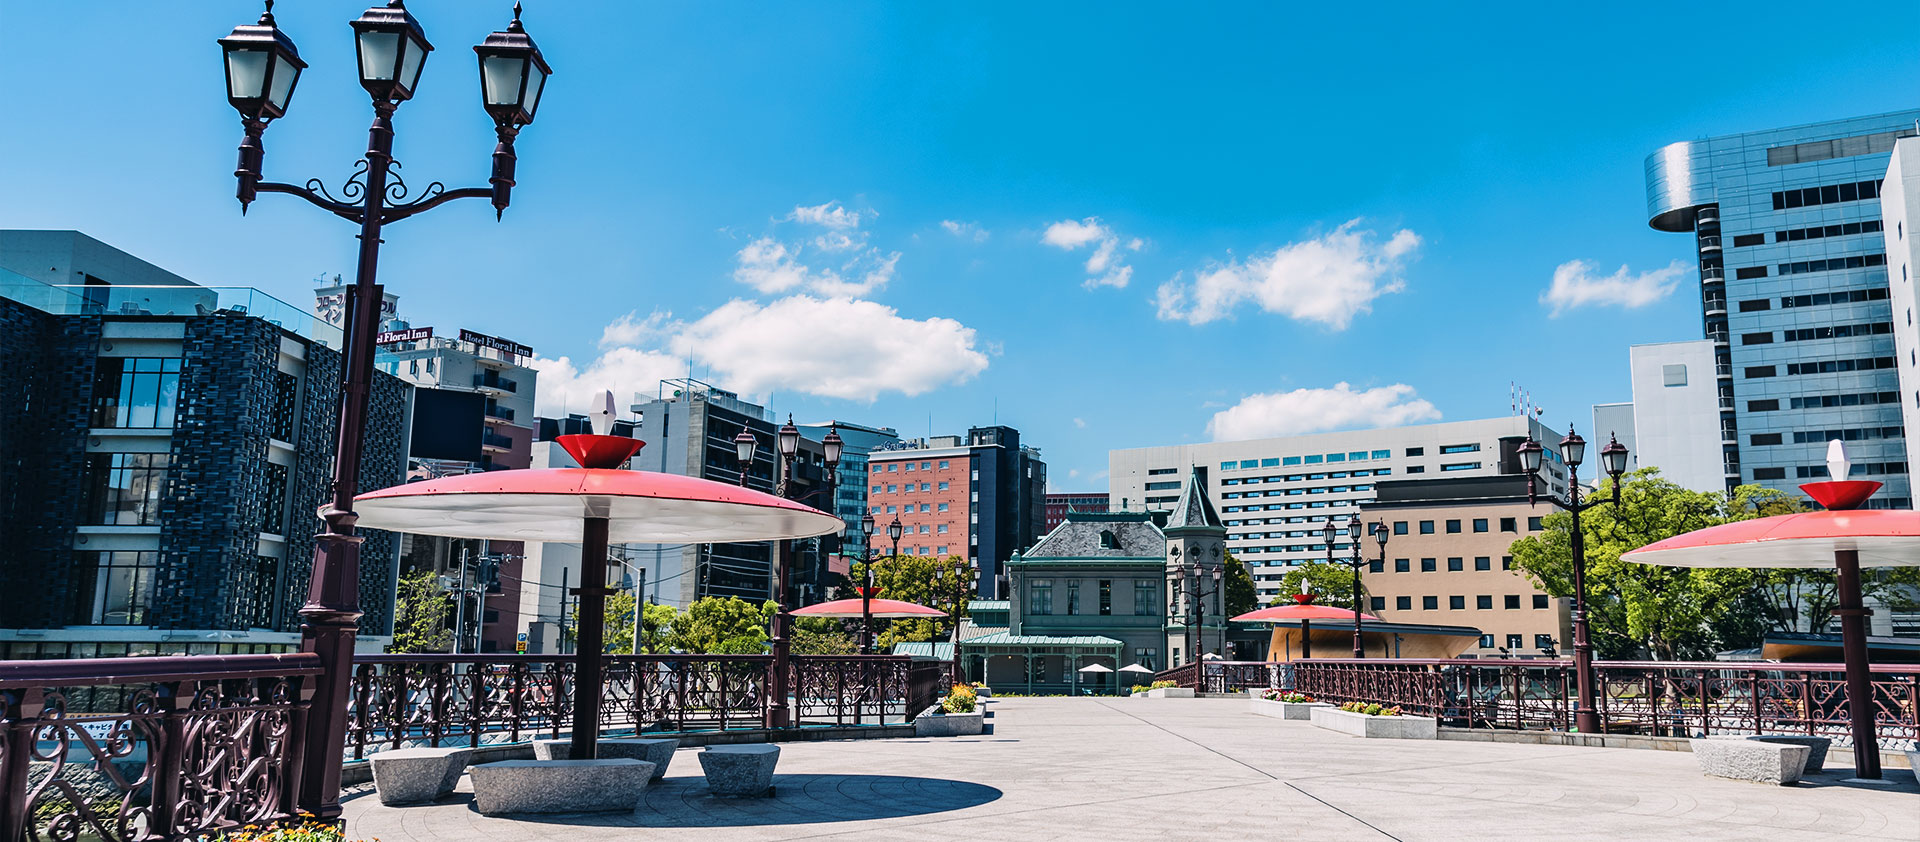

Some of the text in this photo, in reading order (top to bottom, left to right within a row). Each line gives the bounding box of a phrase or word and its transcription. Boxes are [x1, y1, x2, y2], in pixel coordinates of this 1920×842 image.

[316, 293, 346, 309] フローラ
[384, 331, 411, 342] Floral
[411, 329, 428, 338] Inn
[464, 332, 530, 357] Hotel Floral Inn
